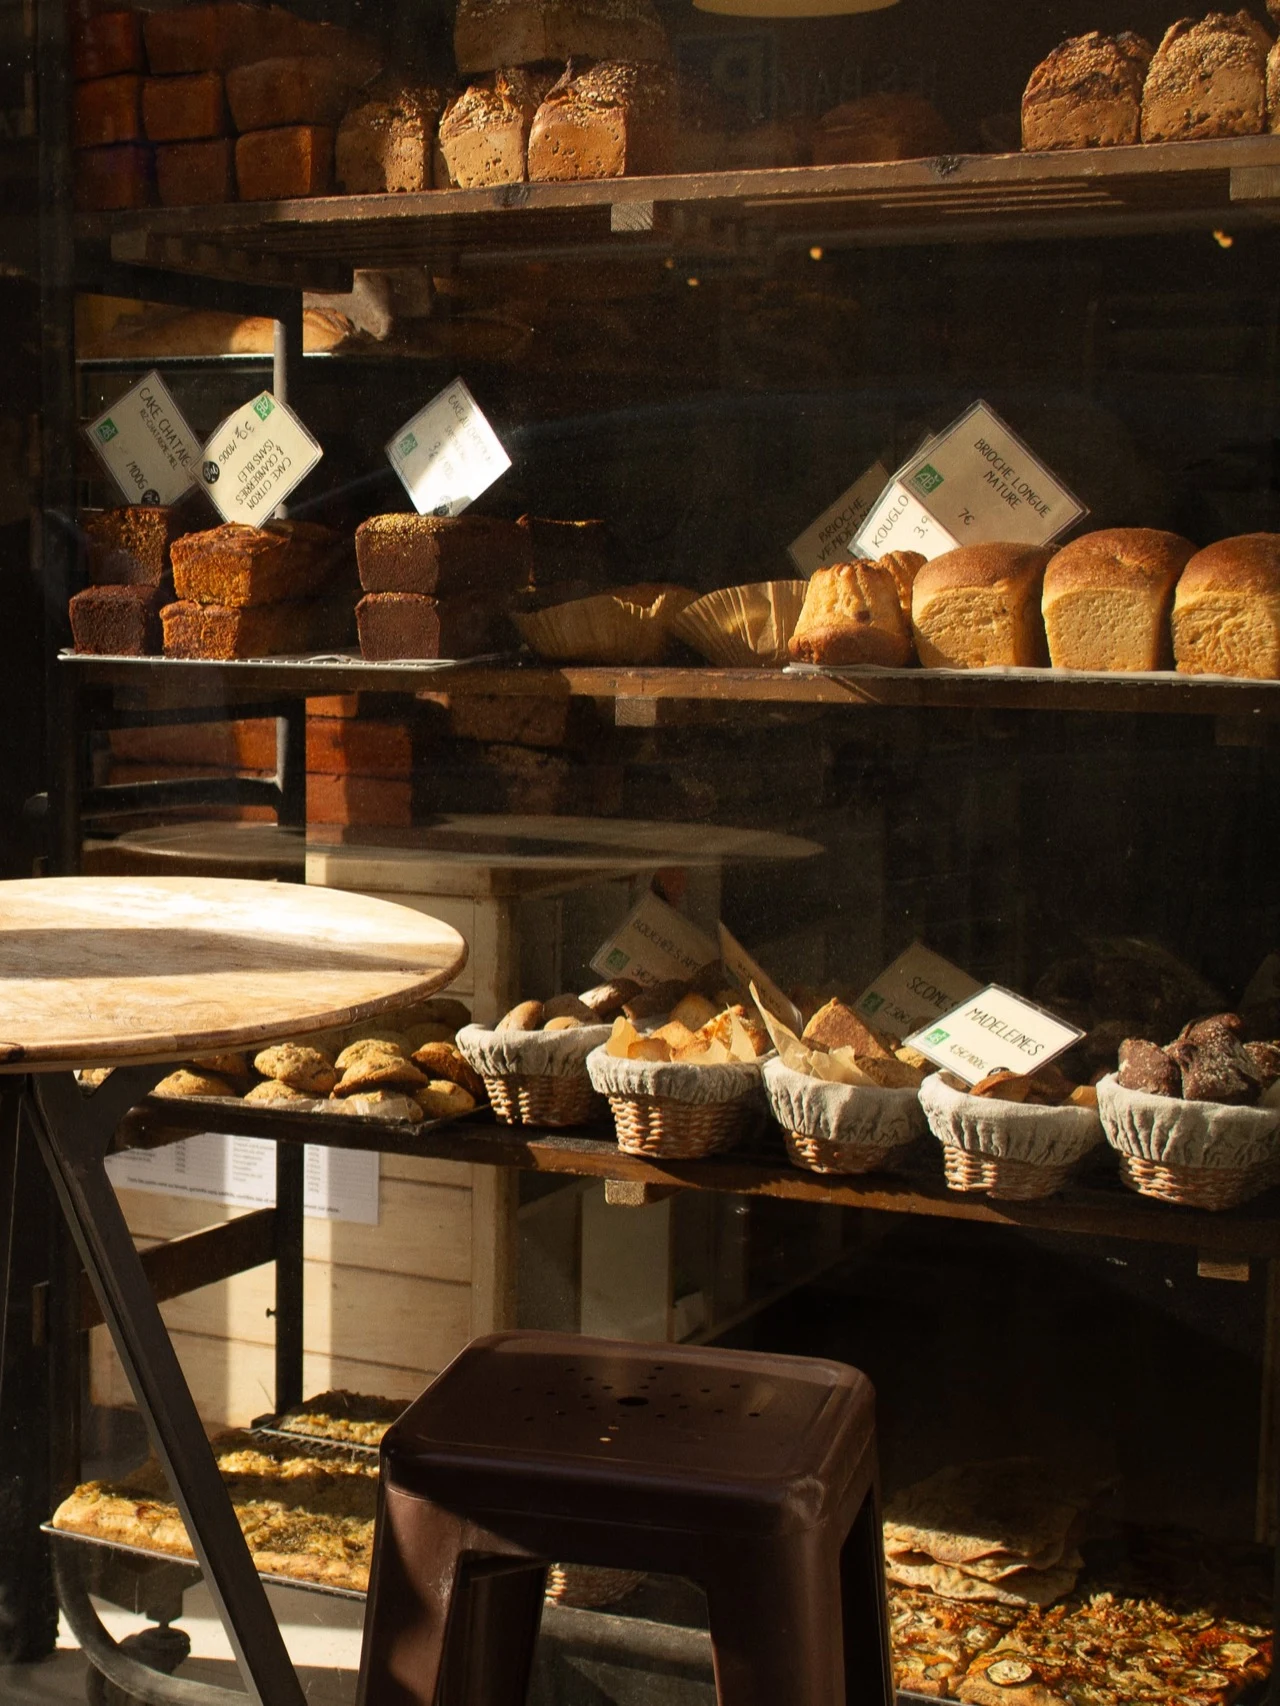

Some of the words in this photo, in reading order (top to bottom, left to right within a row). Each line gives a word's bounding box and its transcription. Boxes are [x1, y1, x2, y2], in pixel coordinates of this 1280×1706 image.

[139, 387, 163, 420] CAKE
[448, 394, 465, 417] CAKE
[252, 438, 275, 466] (SANS
[271, 456, 292, 481] CAKE
[235, 453, 278, 505] CRANBERRIES
[246, 480, 272, 510] CITRON
[974, 438, 1015, 479] BRIOCHE
[1012, 477, 1051, 518] LONGUE
[983, 470, 1022, 510] NATURE
[818, 496, 865, 543] BRIOCHE
[872, 494, 909, 548] KOUGLO
[958, 508, 975, 526] 7€
[965, 1007, 1044, 1056] MADELEINES
